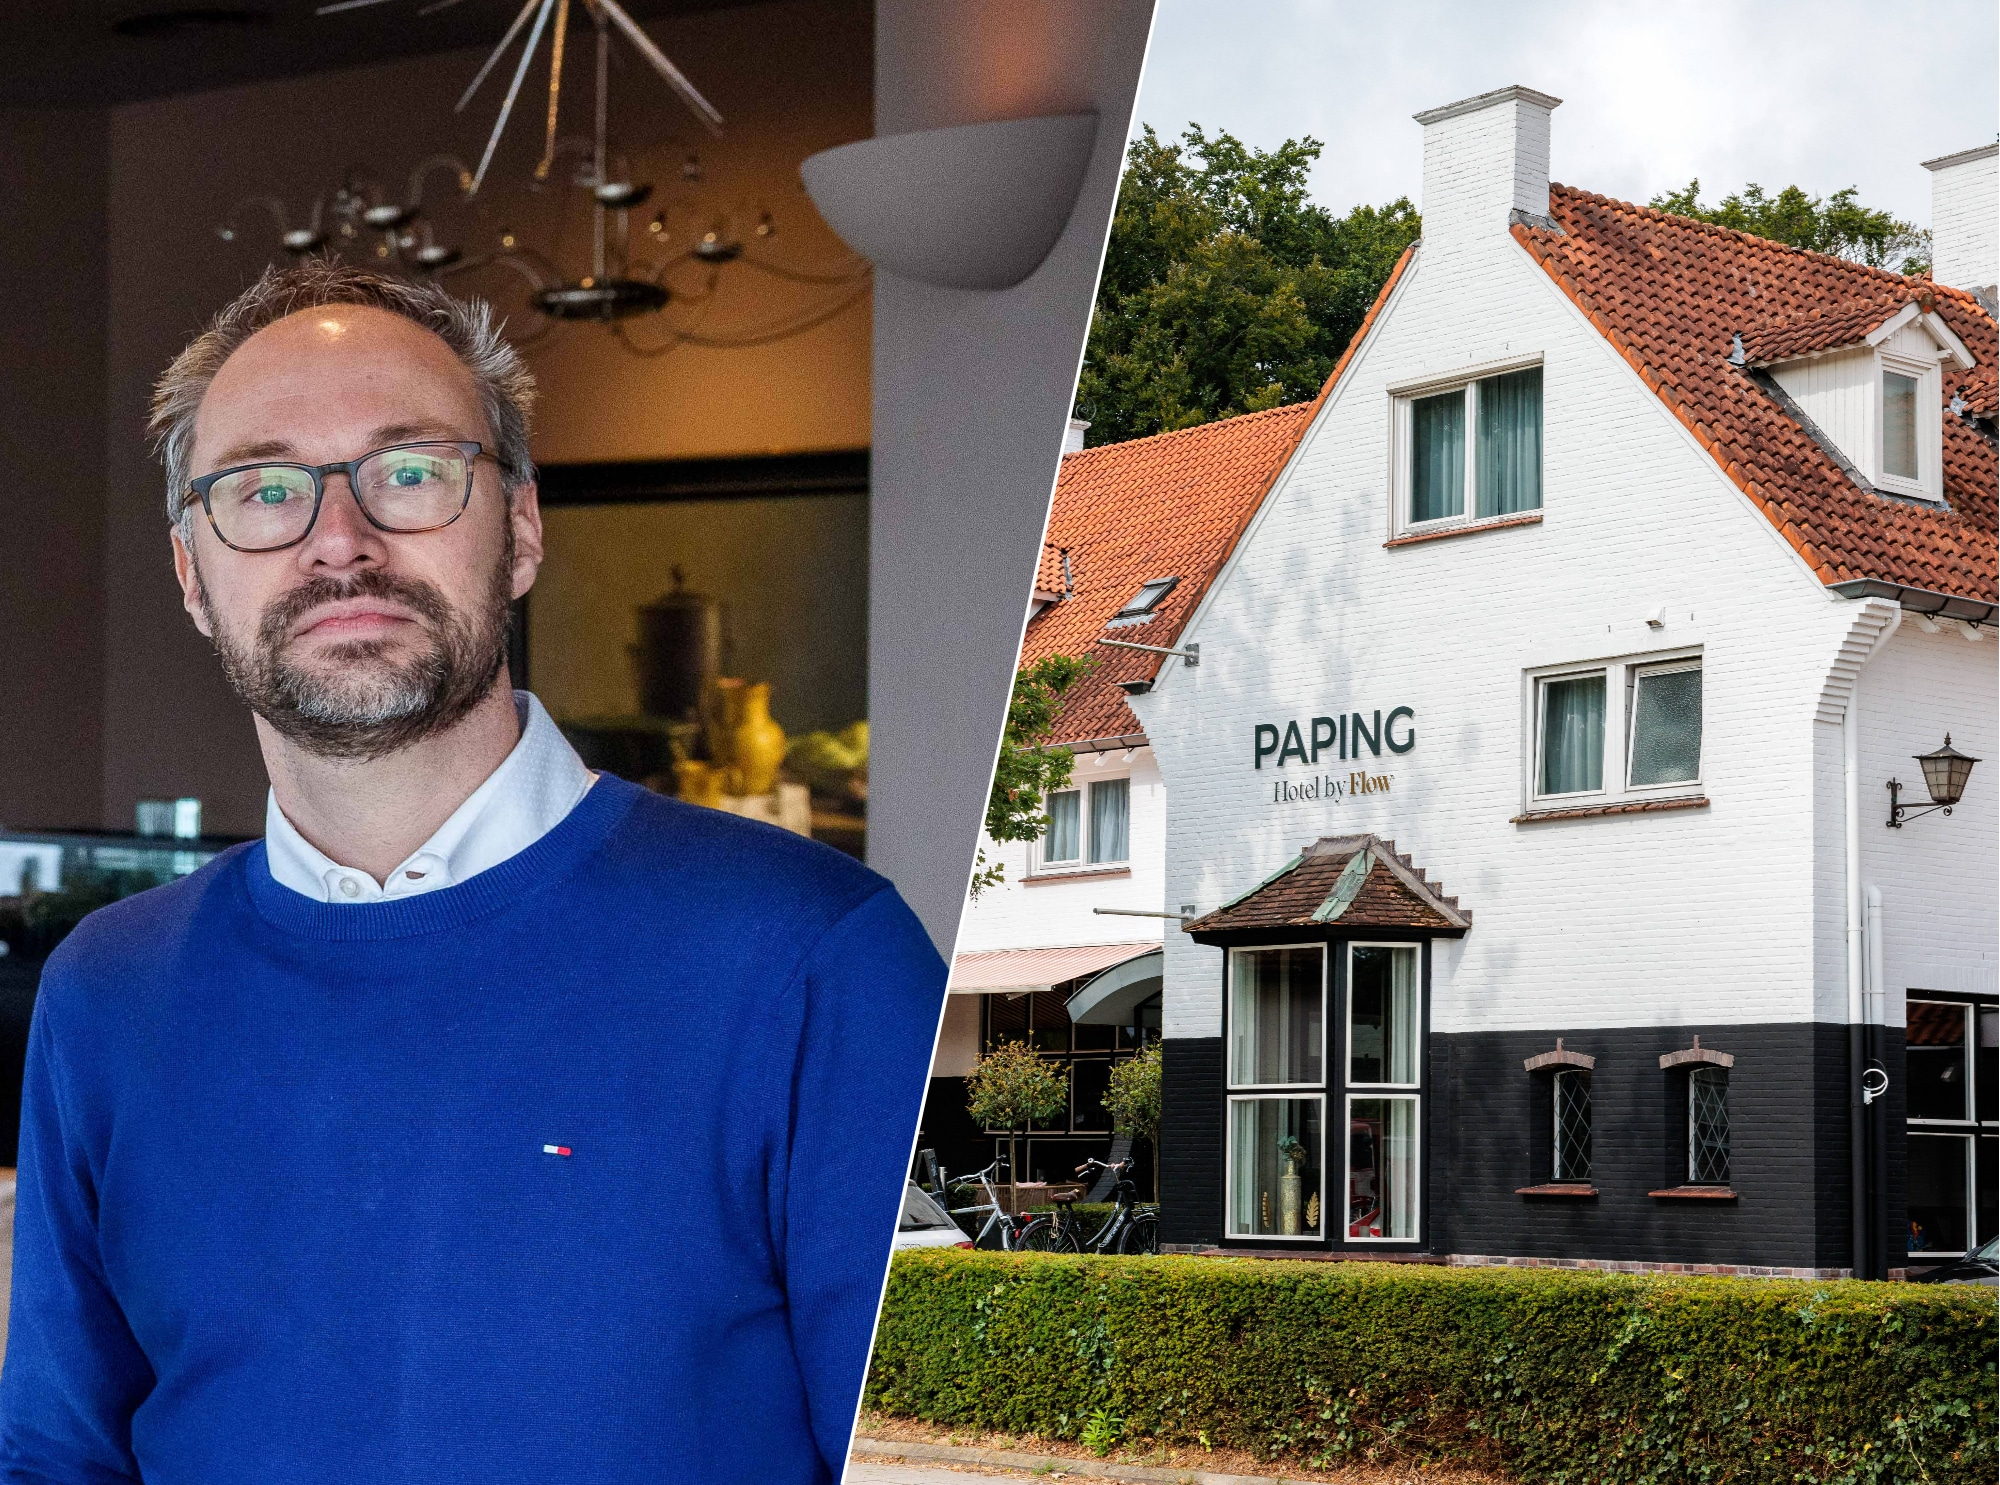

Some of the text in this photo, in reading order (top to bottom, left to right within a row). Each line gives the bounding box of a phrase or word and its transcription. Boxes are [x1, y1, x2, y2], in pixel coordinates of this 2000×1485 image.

[1255, 705, 1415, 769] PAPING
[1273, 770, 1394, 803] Hotel by Flow
